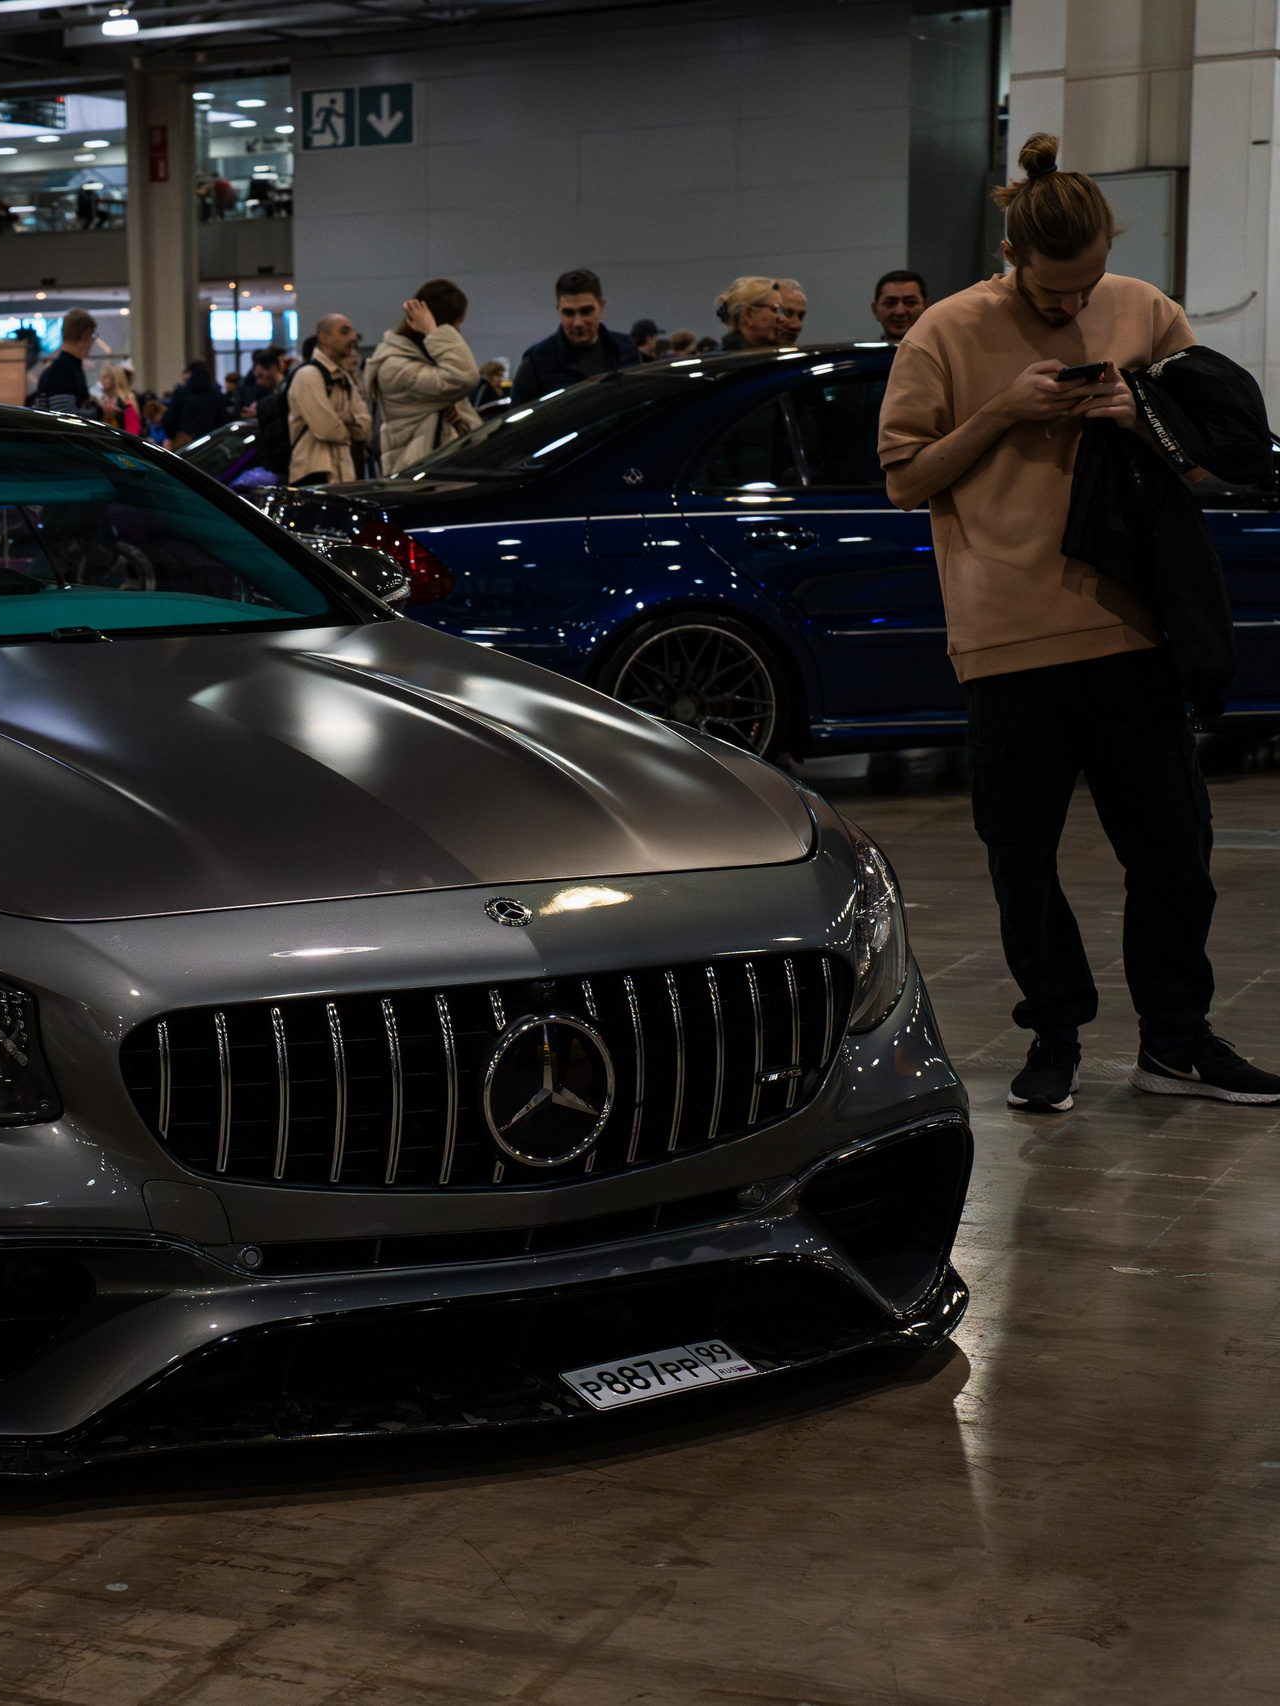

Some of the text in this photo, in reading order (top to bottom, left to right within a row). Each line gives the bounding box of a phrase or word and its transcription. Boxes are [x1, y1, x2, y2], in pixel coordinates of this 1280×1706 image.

[579, 1343, 732, 1402] P887PP 99
[718, 1365, 737, 1376] RUS
